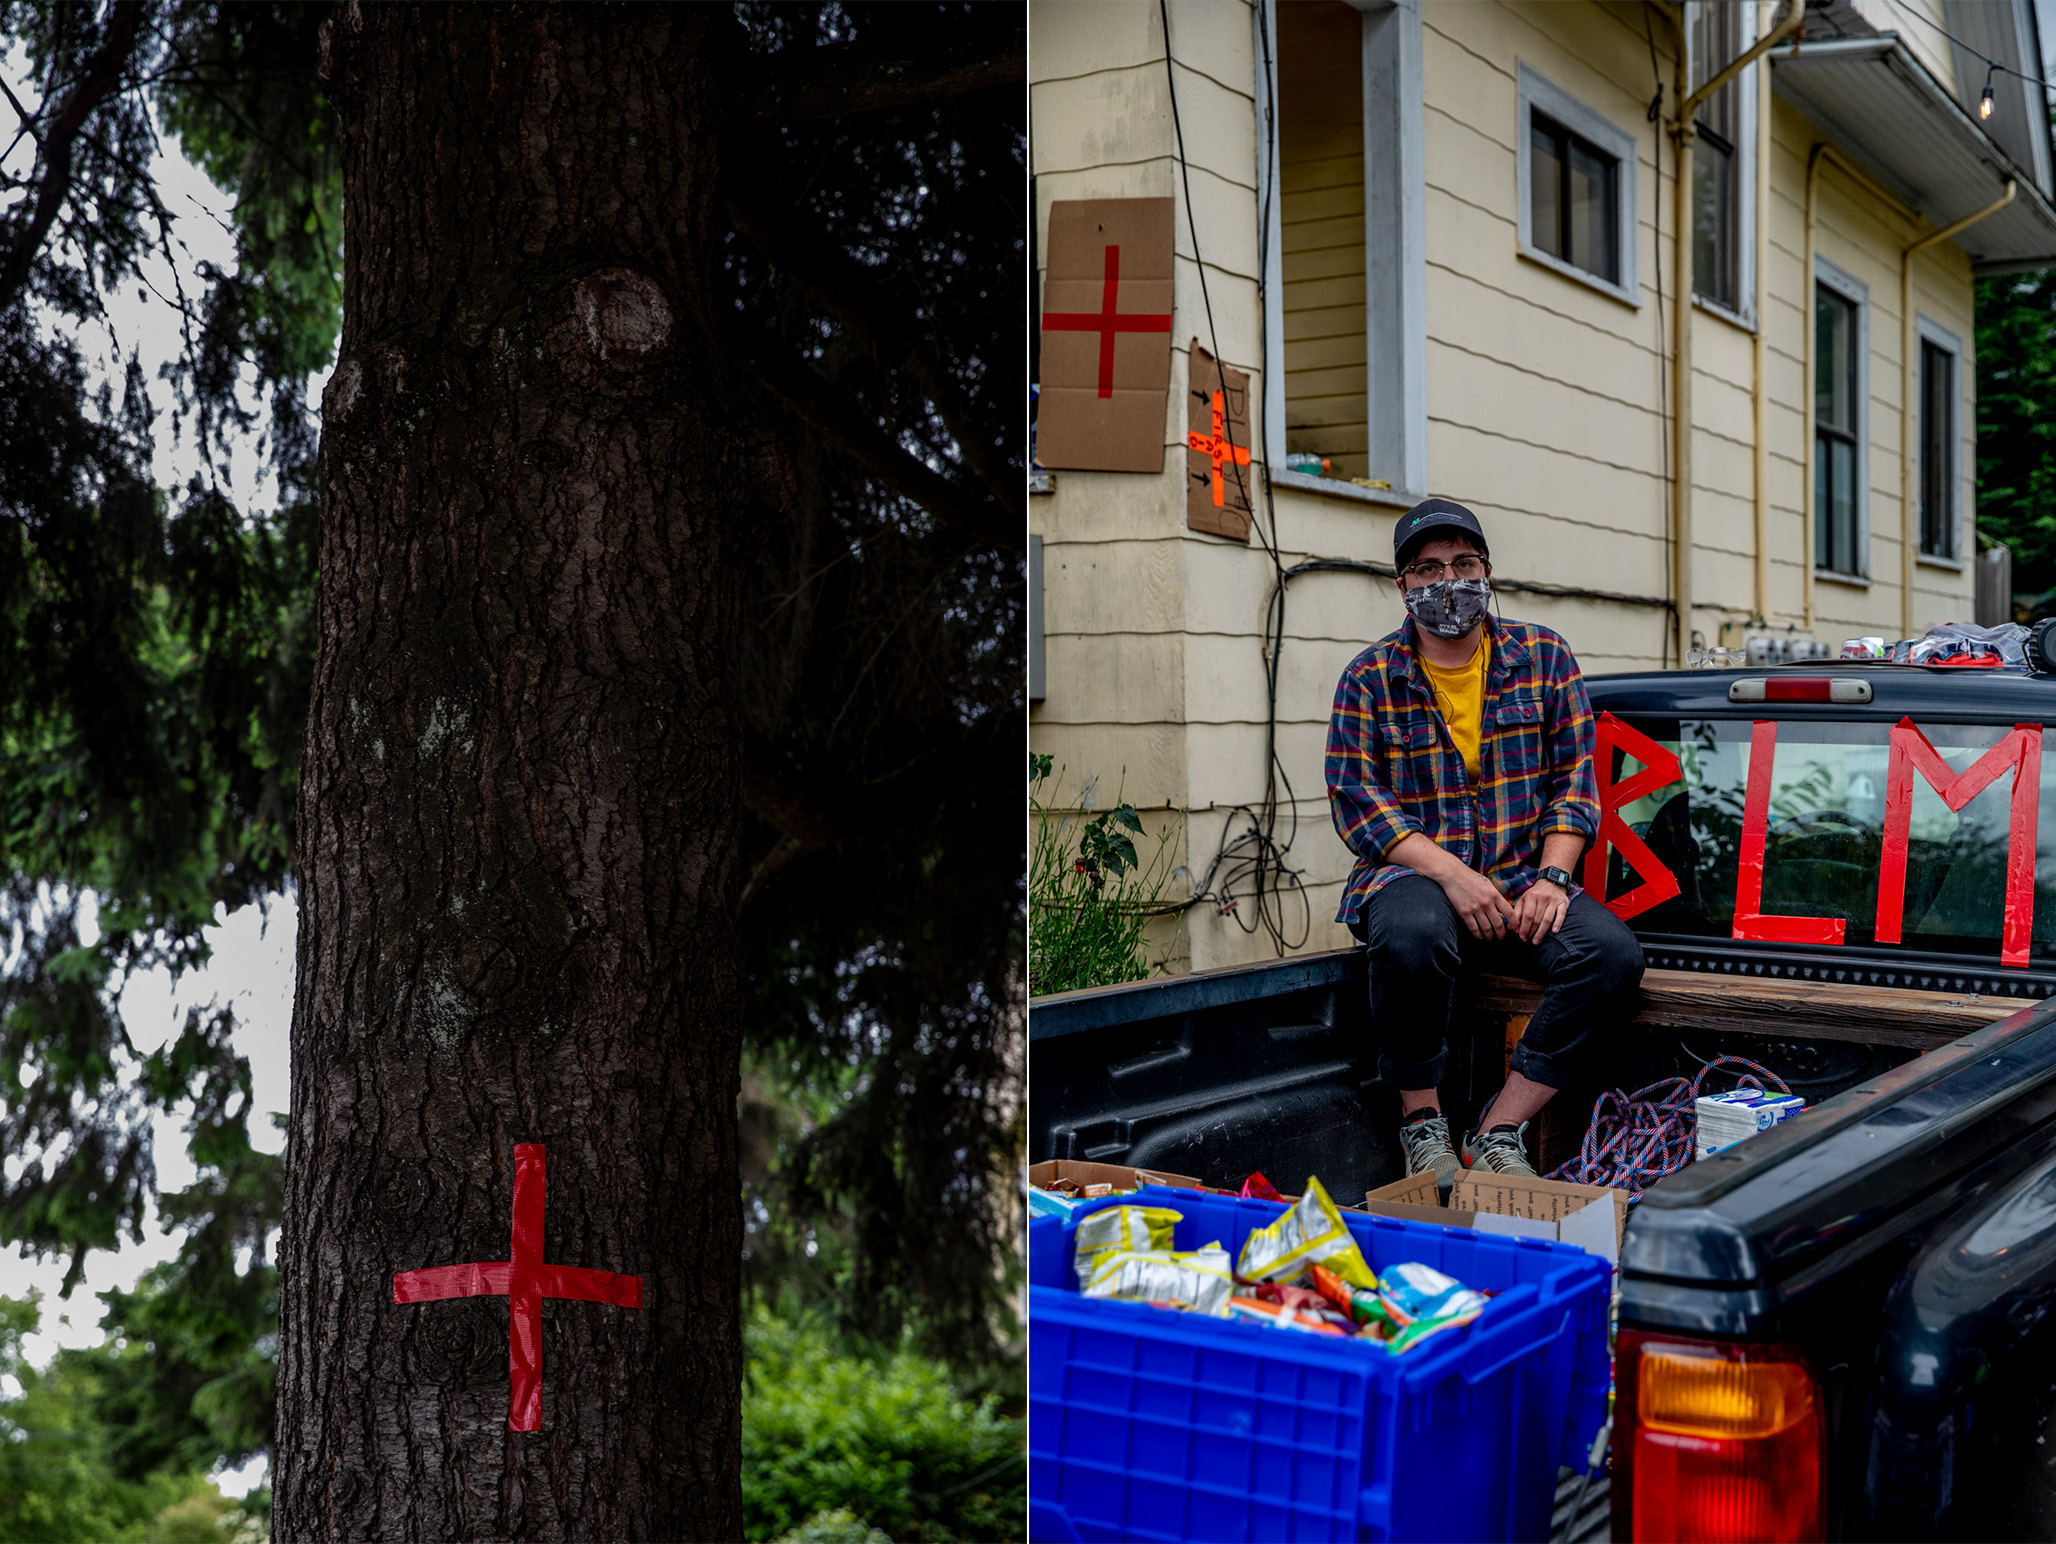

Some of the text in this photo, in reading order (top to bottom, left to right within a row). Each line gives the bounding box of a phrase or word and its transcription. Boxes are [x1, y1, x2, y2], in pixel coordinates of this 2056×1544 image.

[1189, 435, 1214, 452] AID
[1212, 409, 1223, 478] FIRST
[1584, 709, 2042, 968] BLM
